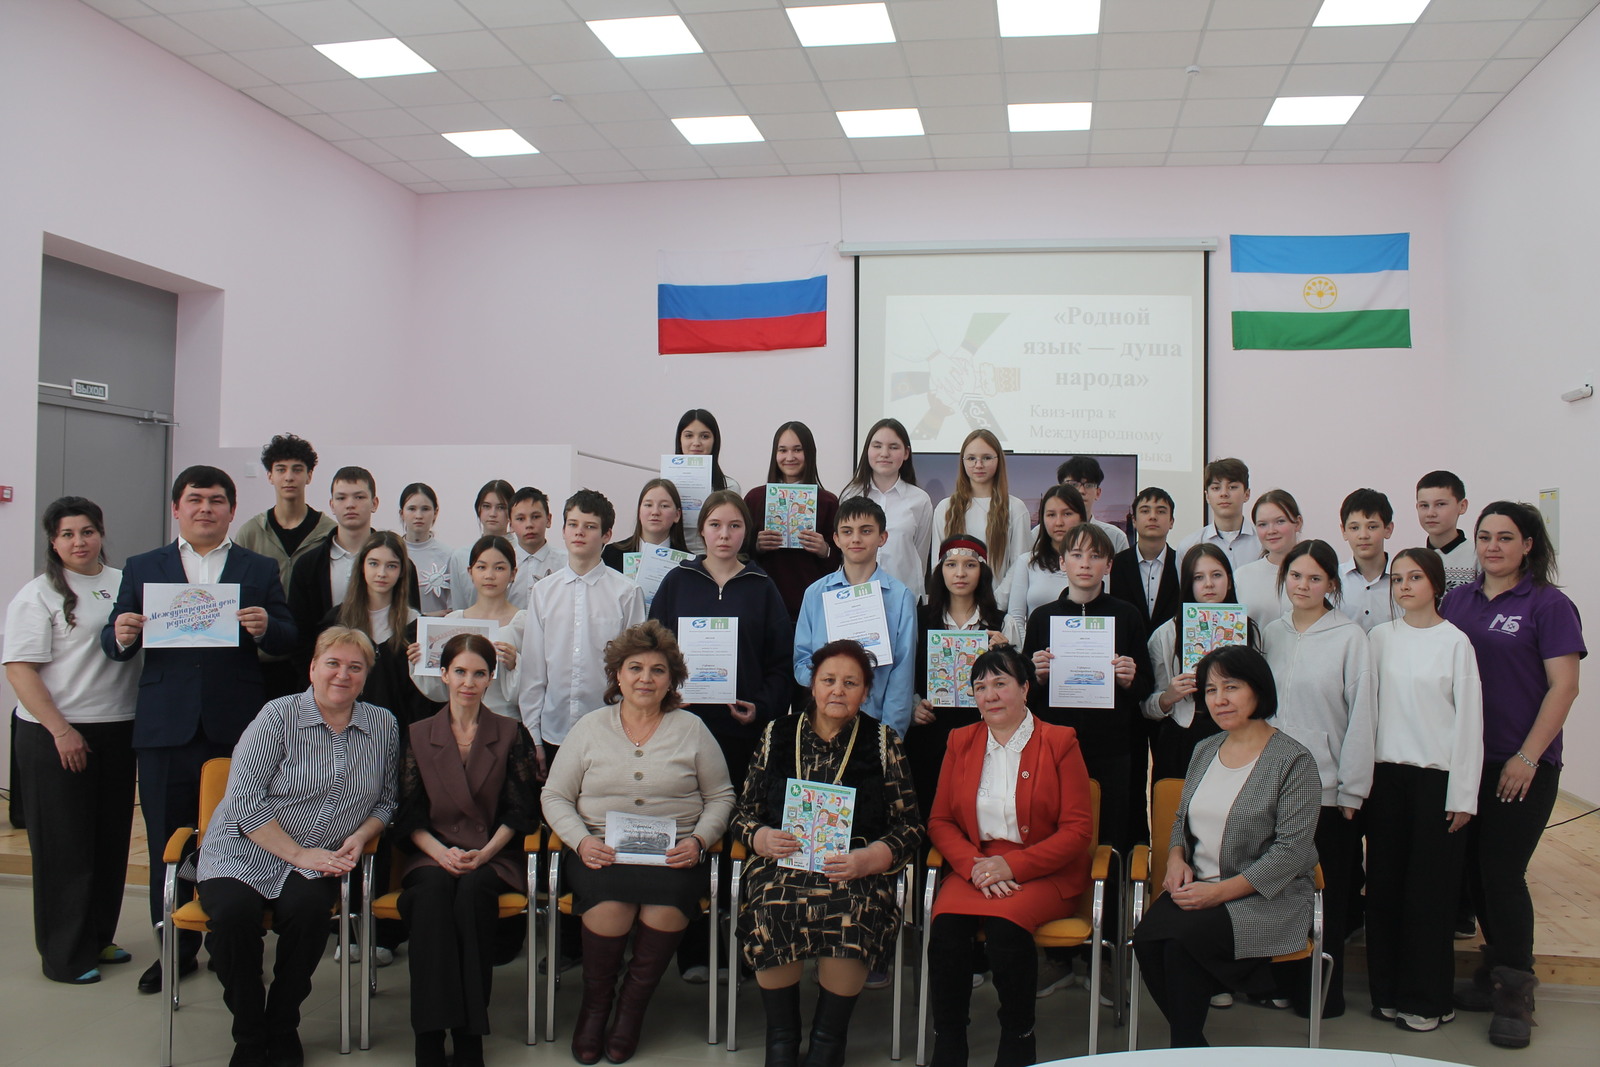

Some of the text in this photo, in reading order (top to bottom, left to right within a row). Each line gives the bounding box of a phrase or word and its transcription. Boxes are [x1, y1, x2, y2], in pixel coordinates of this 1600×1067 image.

[1054, 306, 1150, 328] «Родной
[1024, 340, 1082, 355] язык
[1120, 342, 1183, 361] душа
[76, 383, 105, 397] ВЫХОД
[1055, 371, 1150, 391] народа»
[1030, 404, 1117, 421] Квиз-игра к
[1030, 425, 1164, 444] Международному
[1137, 451, 1173, 464] зыка
[150, 599, 237, 620] Международный день
